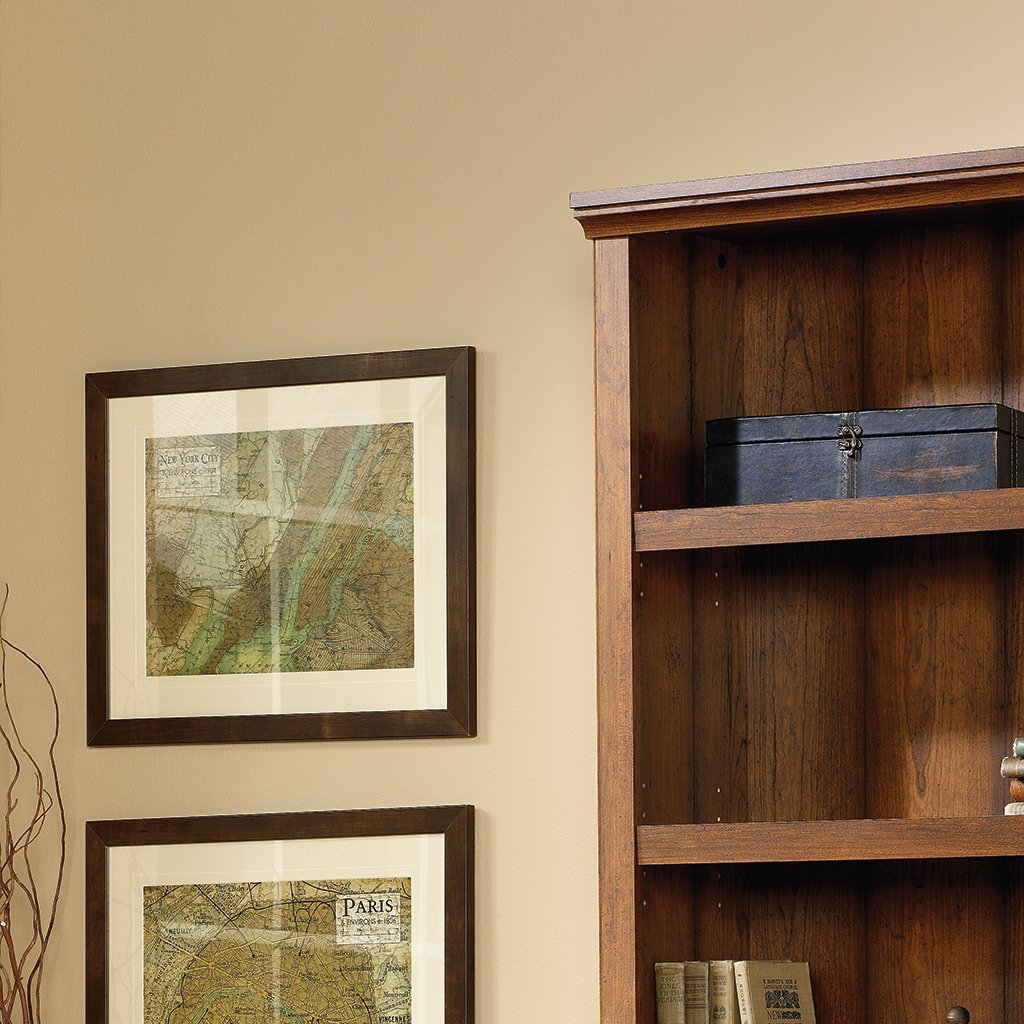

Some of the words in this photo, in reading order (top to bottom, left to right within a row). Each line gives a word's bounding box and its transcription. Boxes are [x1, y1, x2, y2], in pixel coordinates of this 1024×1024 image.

[180, 453, 200, 465] YORK
[201, 452, 219, 464] CITY
[343, 898, 393, 917] PARIS
[767, 1011, 782, 1020] NEW
